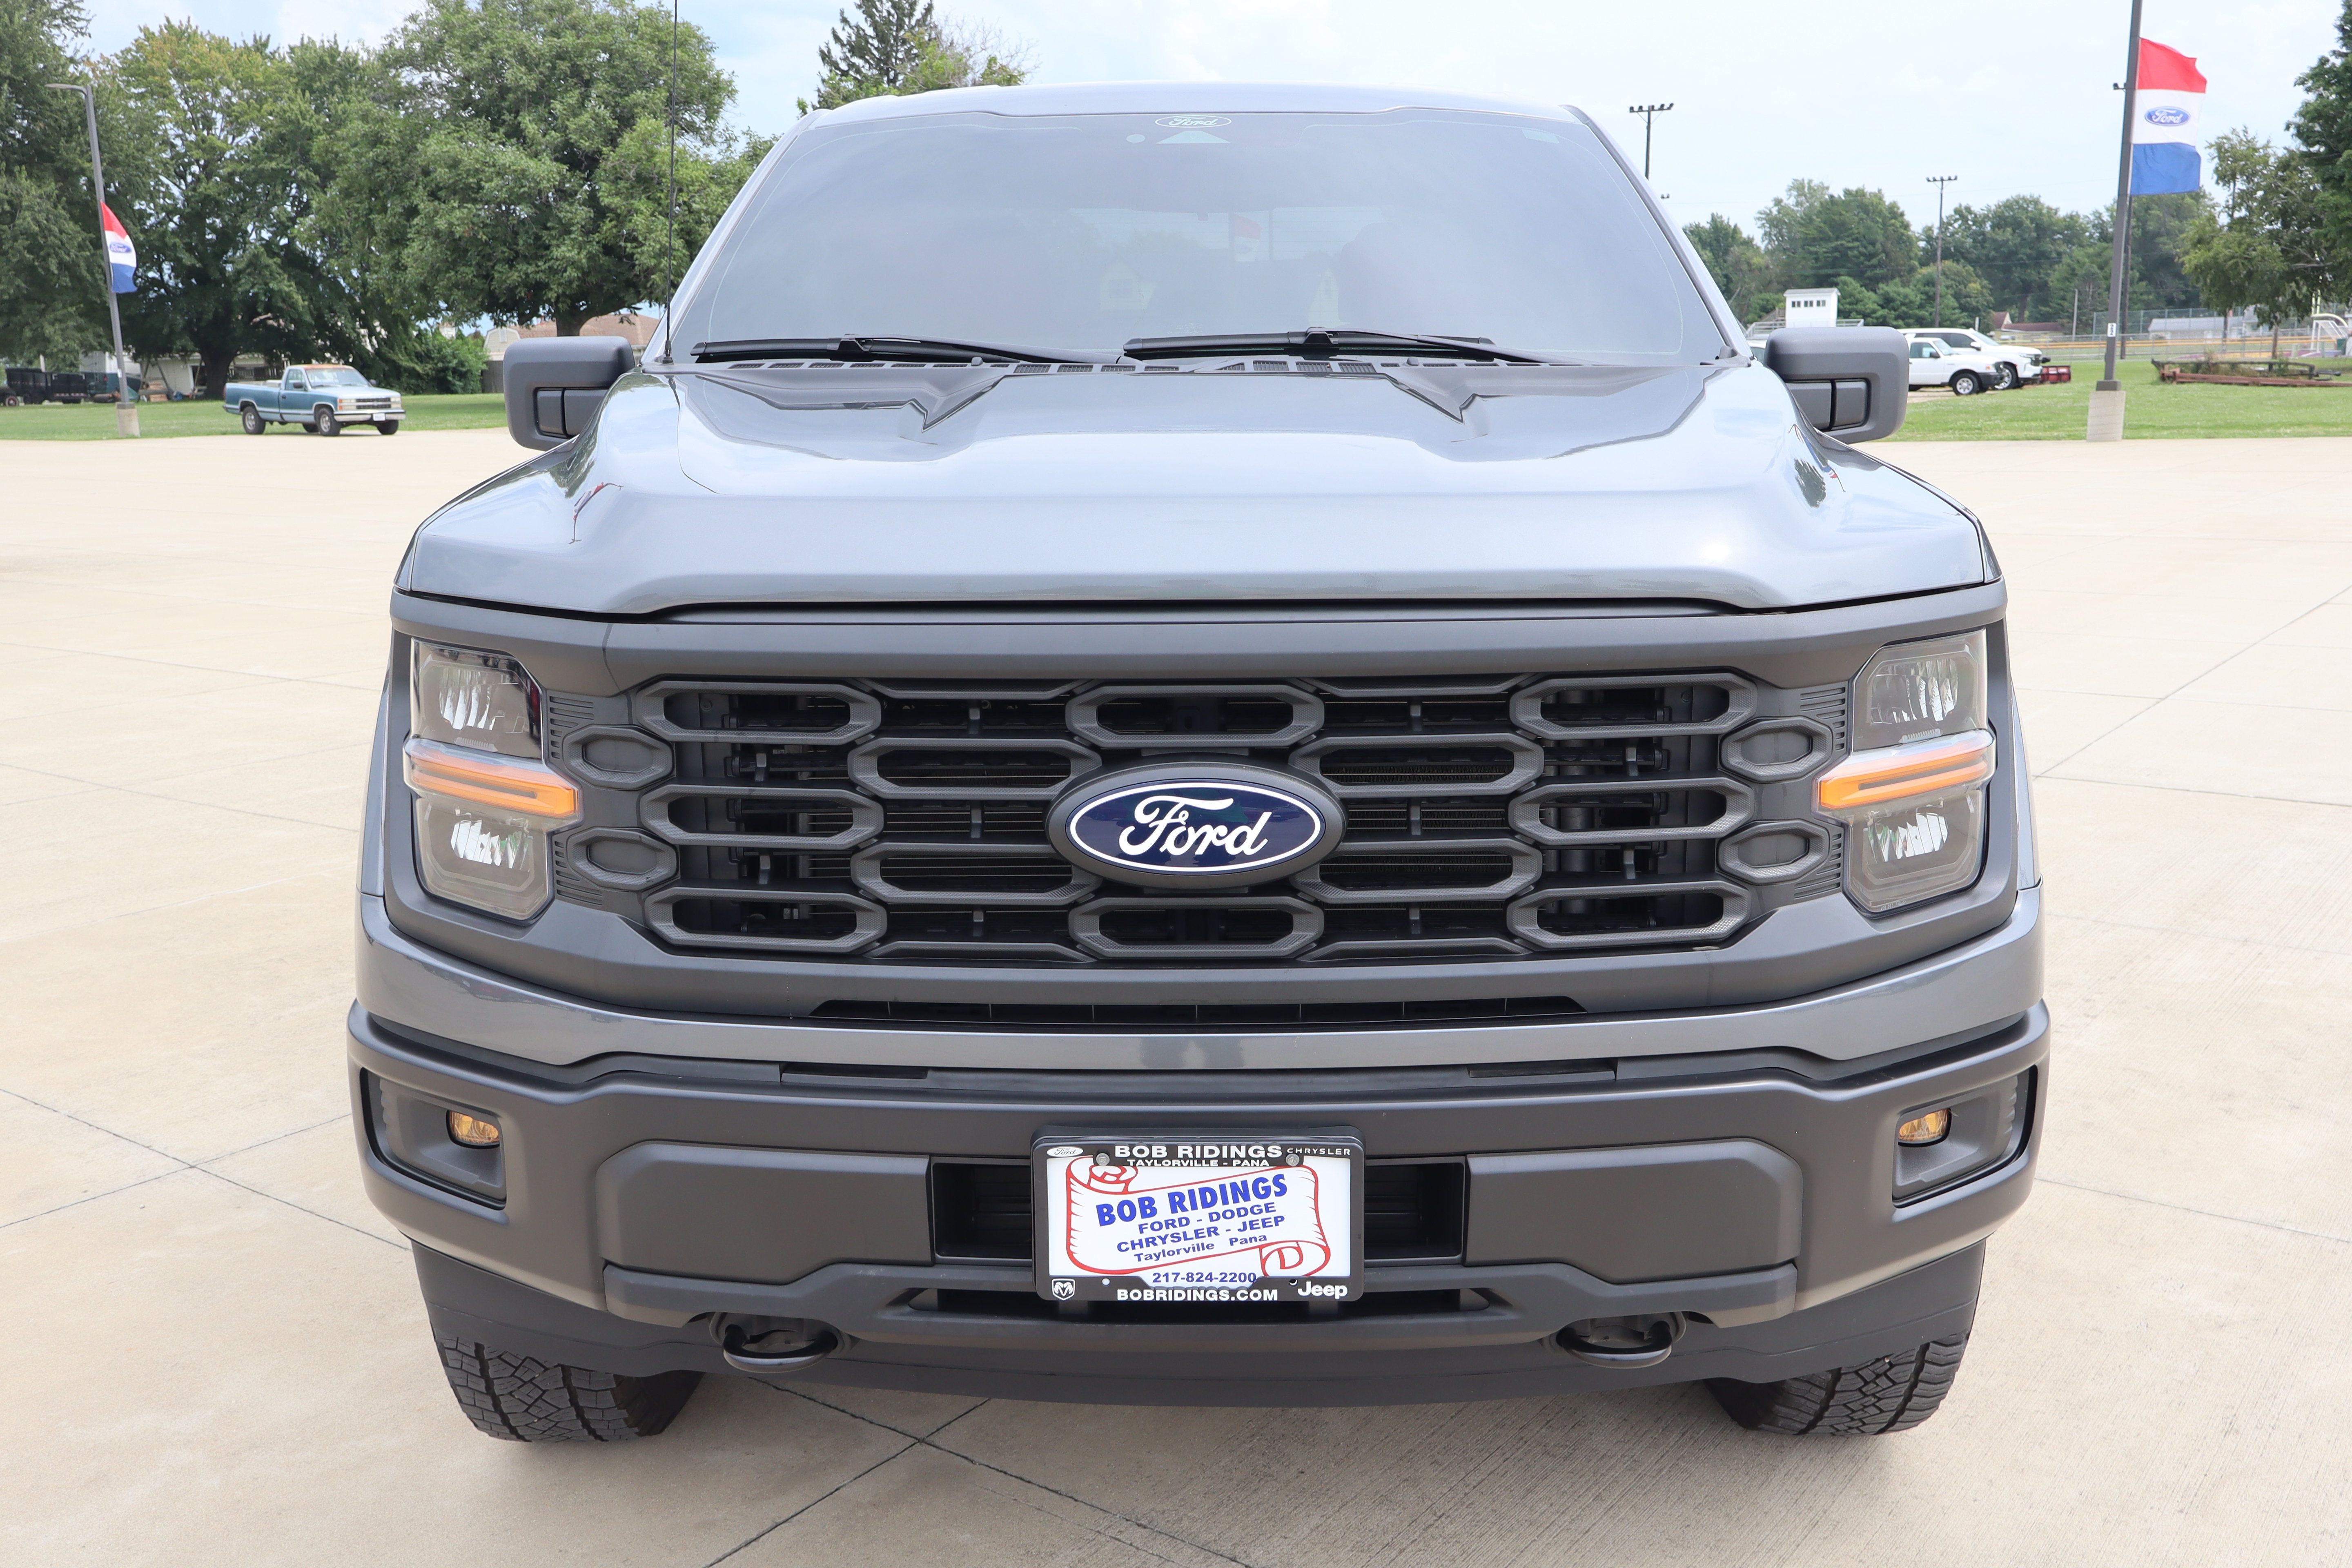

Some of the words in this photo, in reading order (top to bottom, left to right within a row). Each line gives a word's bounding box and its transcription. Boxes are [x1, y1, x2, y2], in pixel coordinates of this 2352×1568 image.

[1168, 116, 1218, 126] Ford
[2152, 109, 2183, 124] Ford
[1118, 795, 1272, 855] Ford
[1115, 1145, 1168, 1158] BOB
[1178, 1145, 1282, 1158] RIDINGS
[1287, 1147, 1351, 1156] CHRYSLER
[1096, 1196, 1158, 1227] BOB
[1167, 1174, 1287, 1214] RIDINGS
[1138, 1216, 1190, 1234] FORD
[1208, 1202, 1276, 1222] DODGE
[1117, 1226, 1220, 1252] CHRYSLER
[1237, 1215, 1285, 1232] JEEP
[1134, 1243, 1215, 1262] Taylorville
[1229, 1234, 1267, 1246] Pana
[1152, 1272, 1256, 1283] 217-824-2200
[1117, 1289, 1278, 1301] BOBRIDINGS.COM
[1297, 1281, 1348, 1300] Jeep
